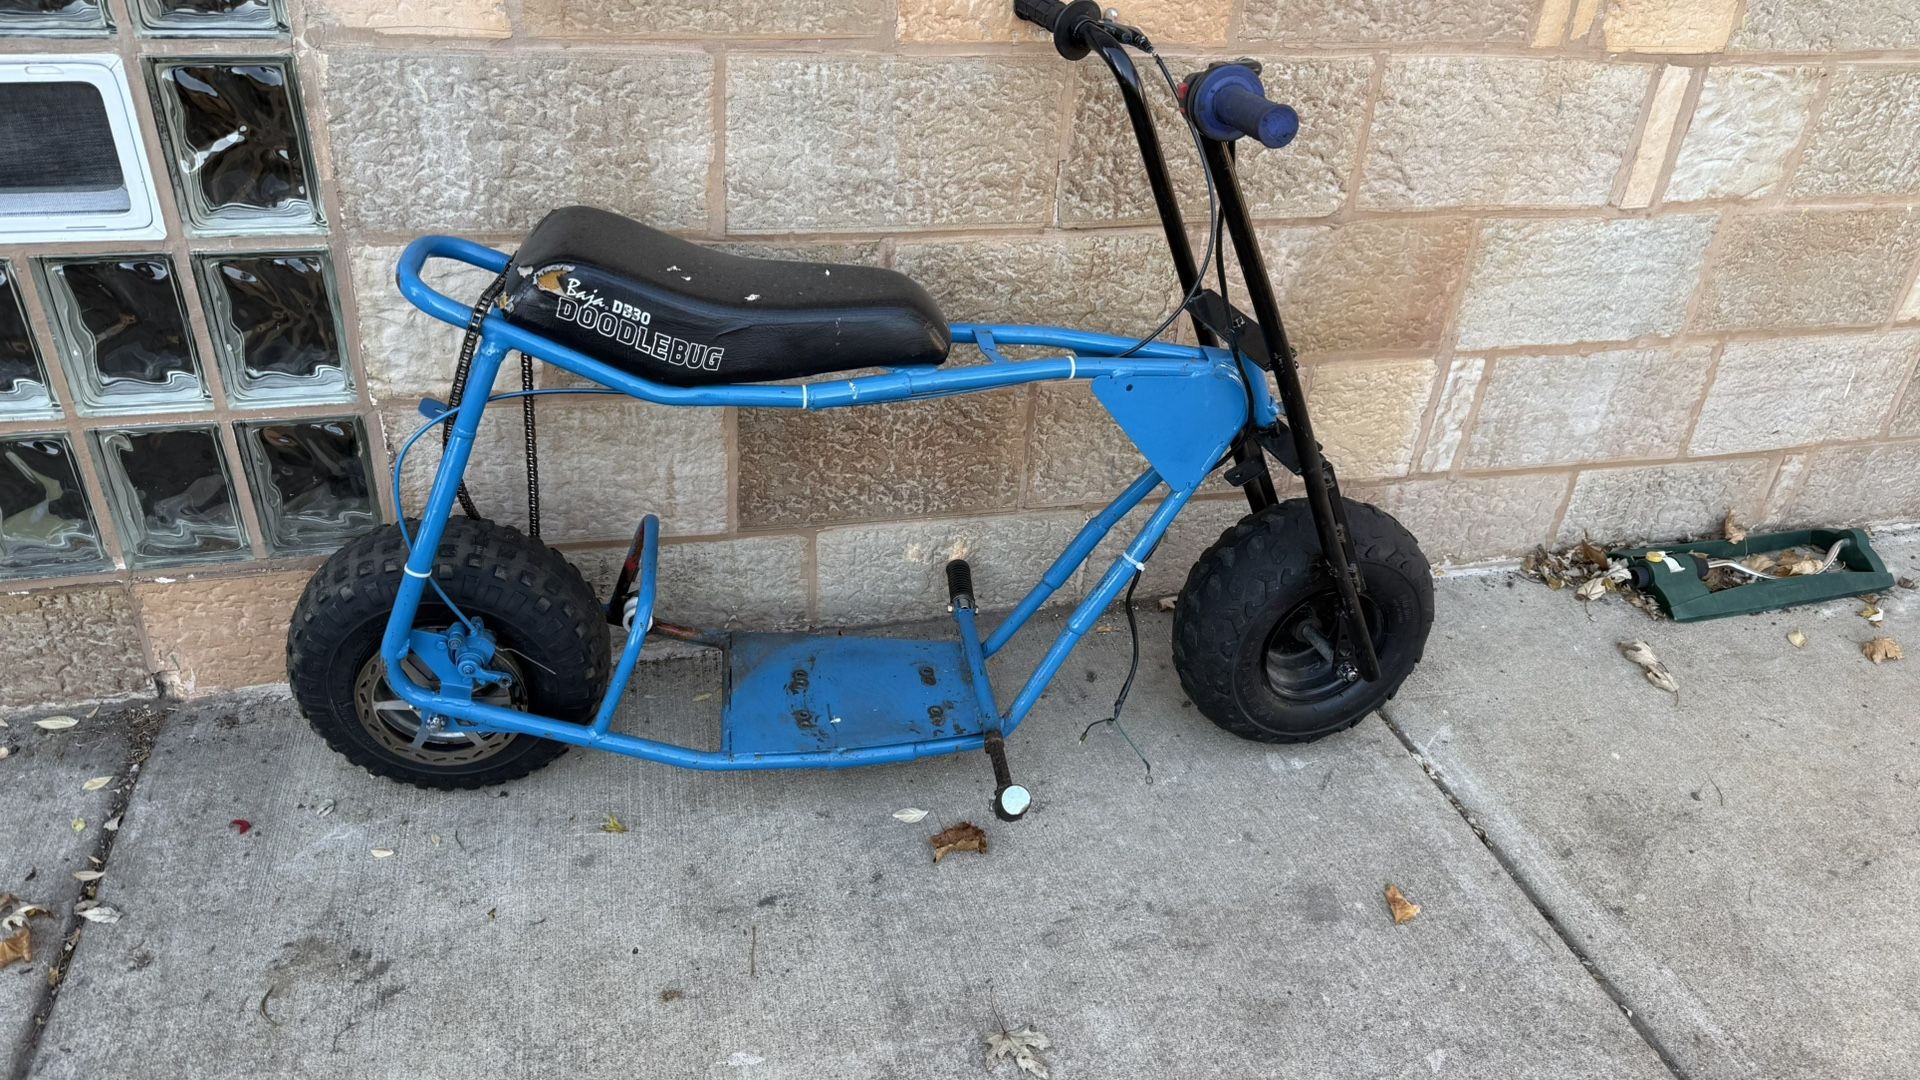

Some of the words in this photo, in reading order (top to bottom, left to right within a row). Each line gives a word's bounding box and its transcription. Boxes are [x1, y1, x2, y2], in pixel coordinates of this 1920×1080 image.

[566, 278, 605, 308] Baja
[612, 299, 651, 325] DB30
[556, 296, 724, 371] DOODLEBUG
